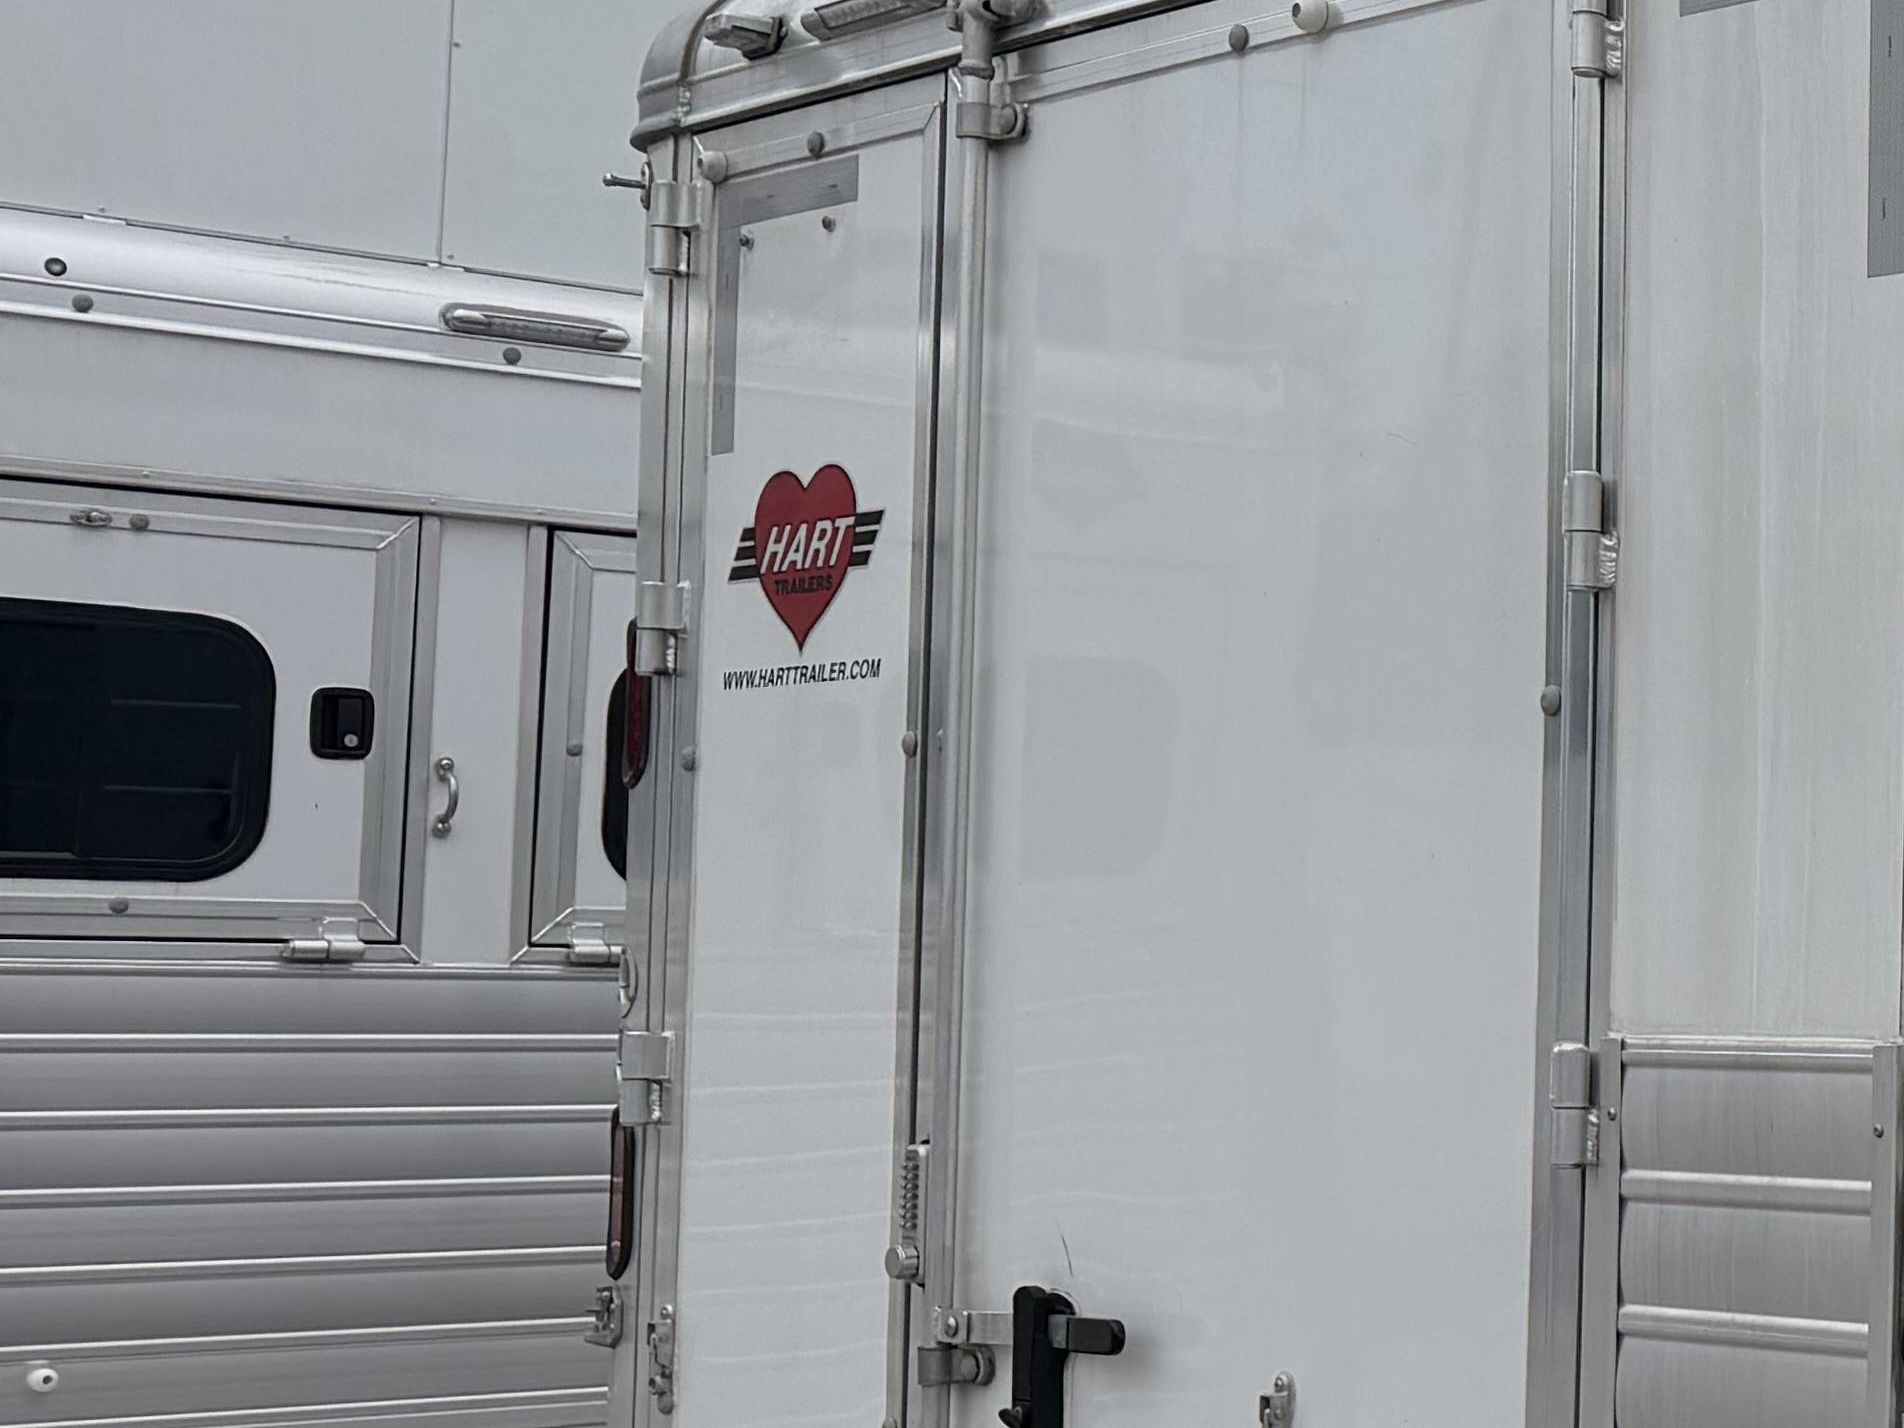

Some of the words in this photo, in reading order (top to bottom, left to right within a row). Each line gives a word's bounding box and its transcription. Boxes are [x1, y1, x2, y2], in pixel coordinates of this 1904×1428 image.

[760, 516, 856, 574] HART
[775, 574, 833, 596] TRAILERS
[723, 658, 881, 690] WWW.HARTTRAILER.COM
